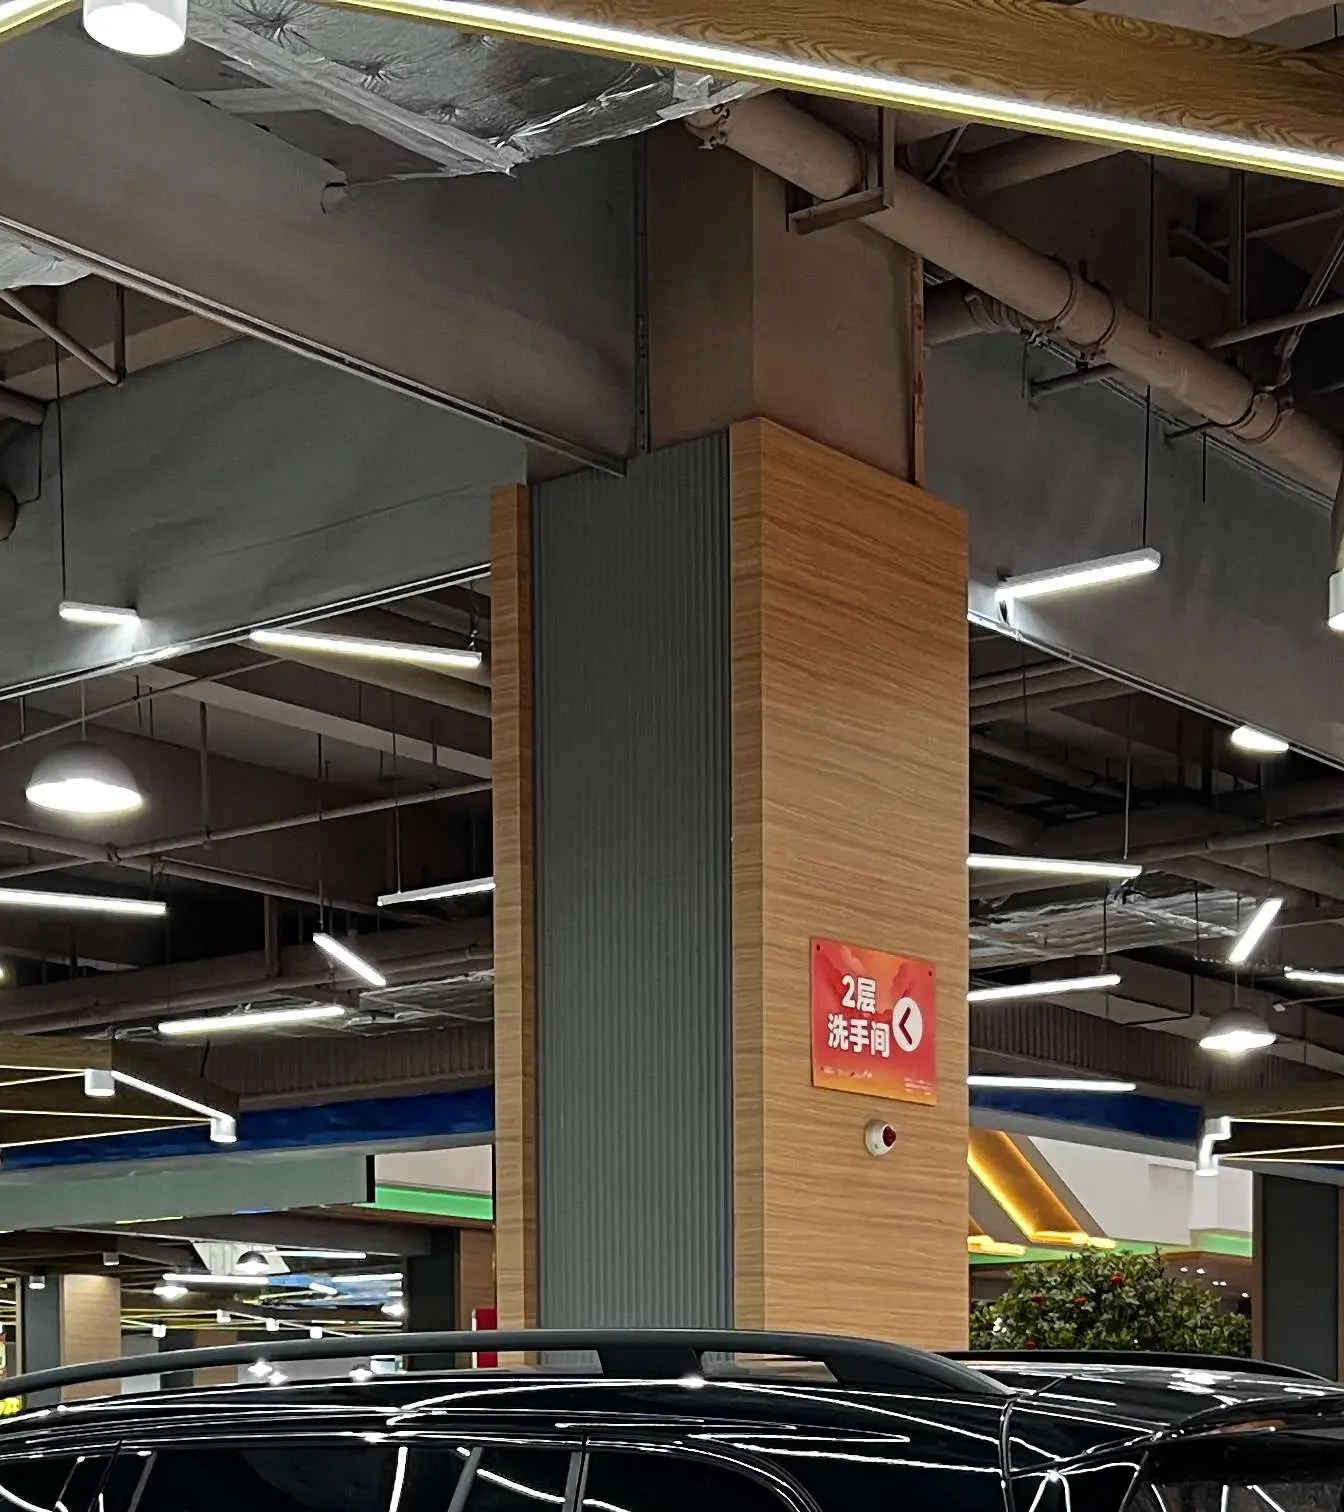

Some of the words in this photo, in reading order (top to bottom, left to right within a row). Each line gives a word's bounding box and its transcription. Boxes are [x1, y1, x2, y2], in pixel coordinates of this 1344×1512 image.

[840, 974, 877, 1015] 2层
[827, 1012, 891, 1059] 洗手间
